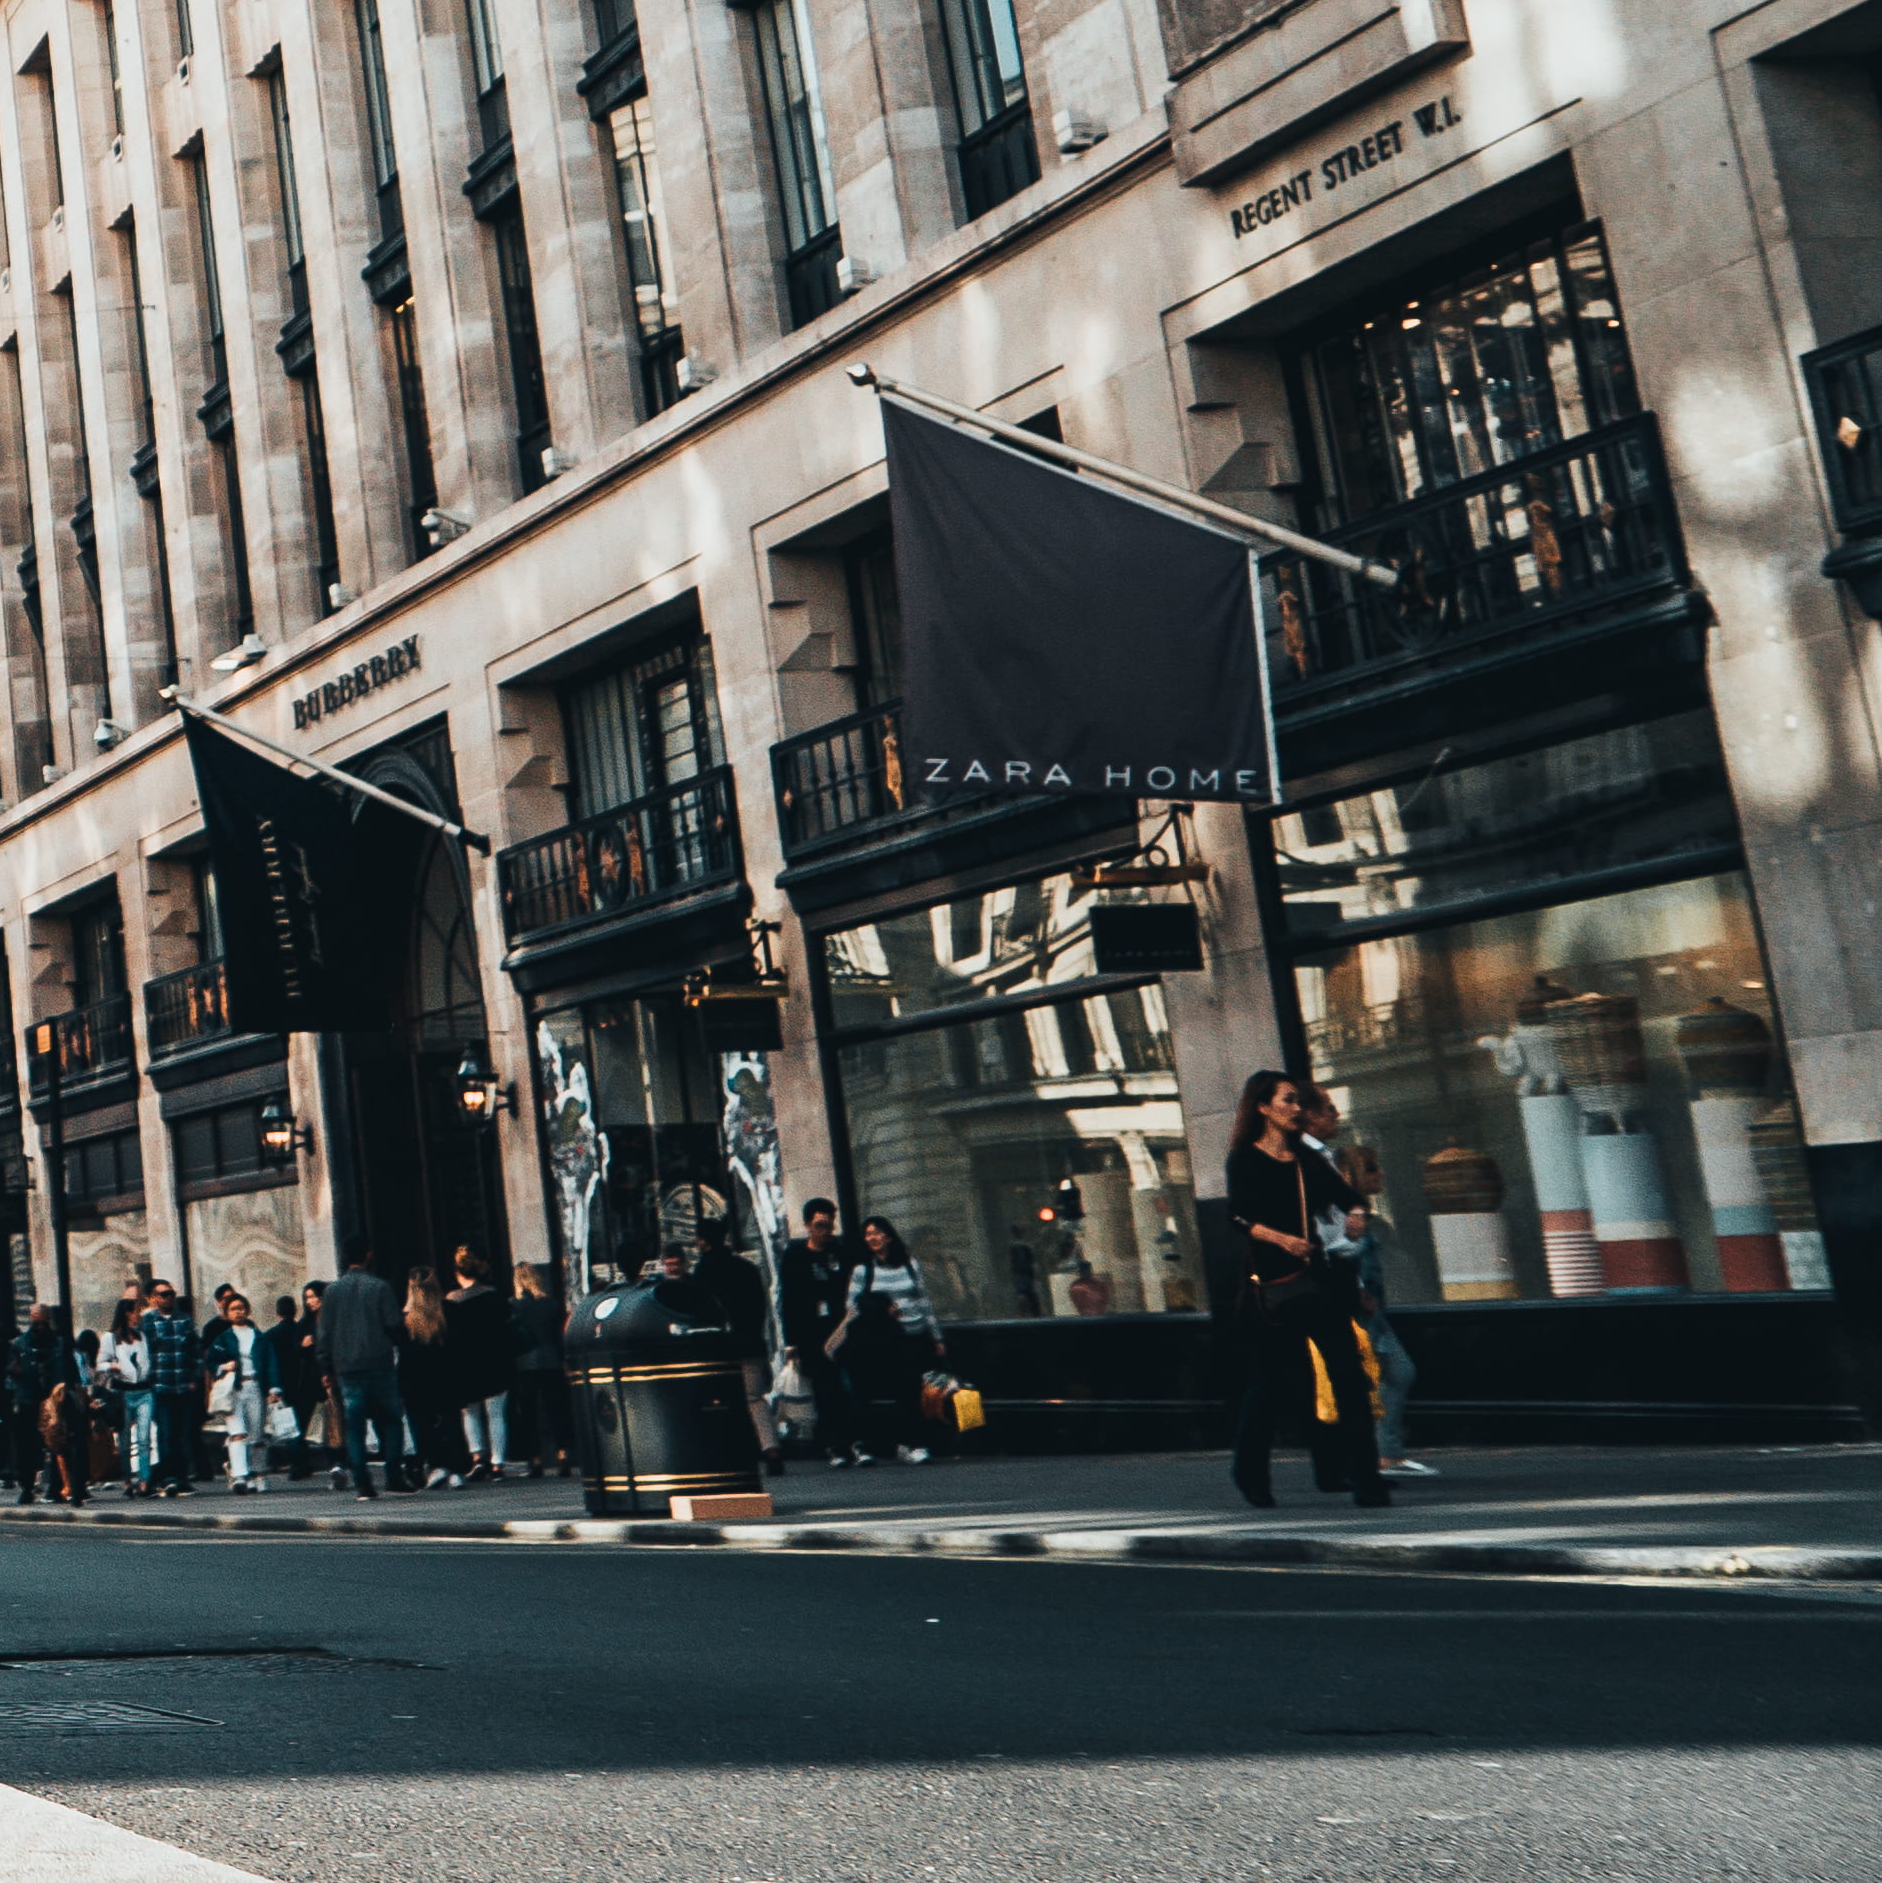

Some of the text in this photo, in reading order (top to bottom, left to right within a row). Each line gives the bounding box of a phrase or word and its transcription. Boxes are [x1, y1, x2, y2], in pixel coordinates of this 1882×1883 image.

[1229, 169, 1312, 239] REGENT
[1319, 119, 1403, 191] STREET
[291, 633, 422, 731] BURBERRY
[923, 757, 1259, 796] ZARA HOME
